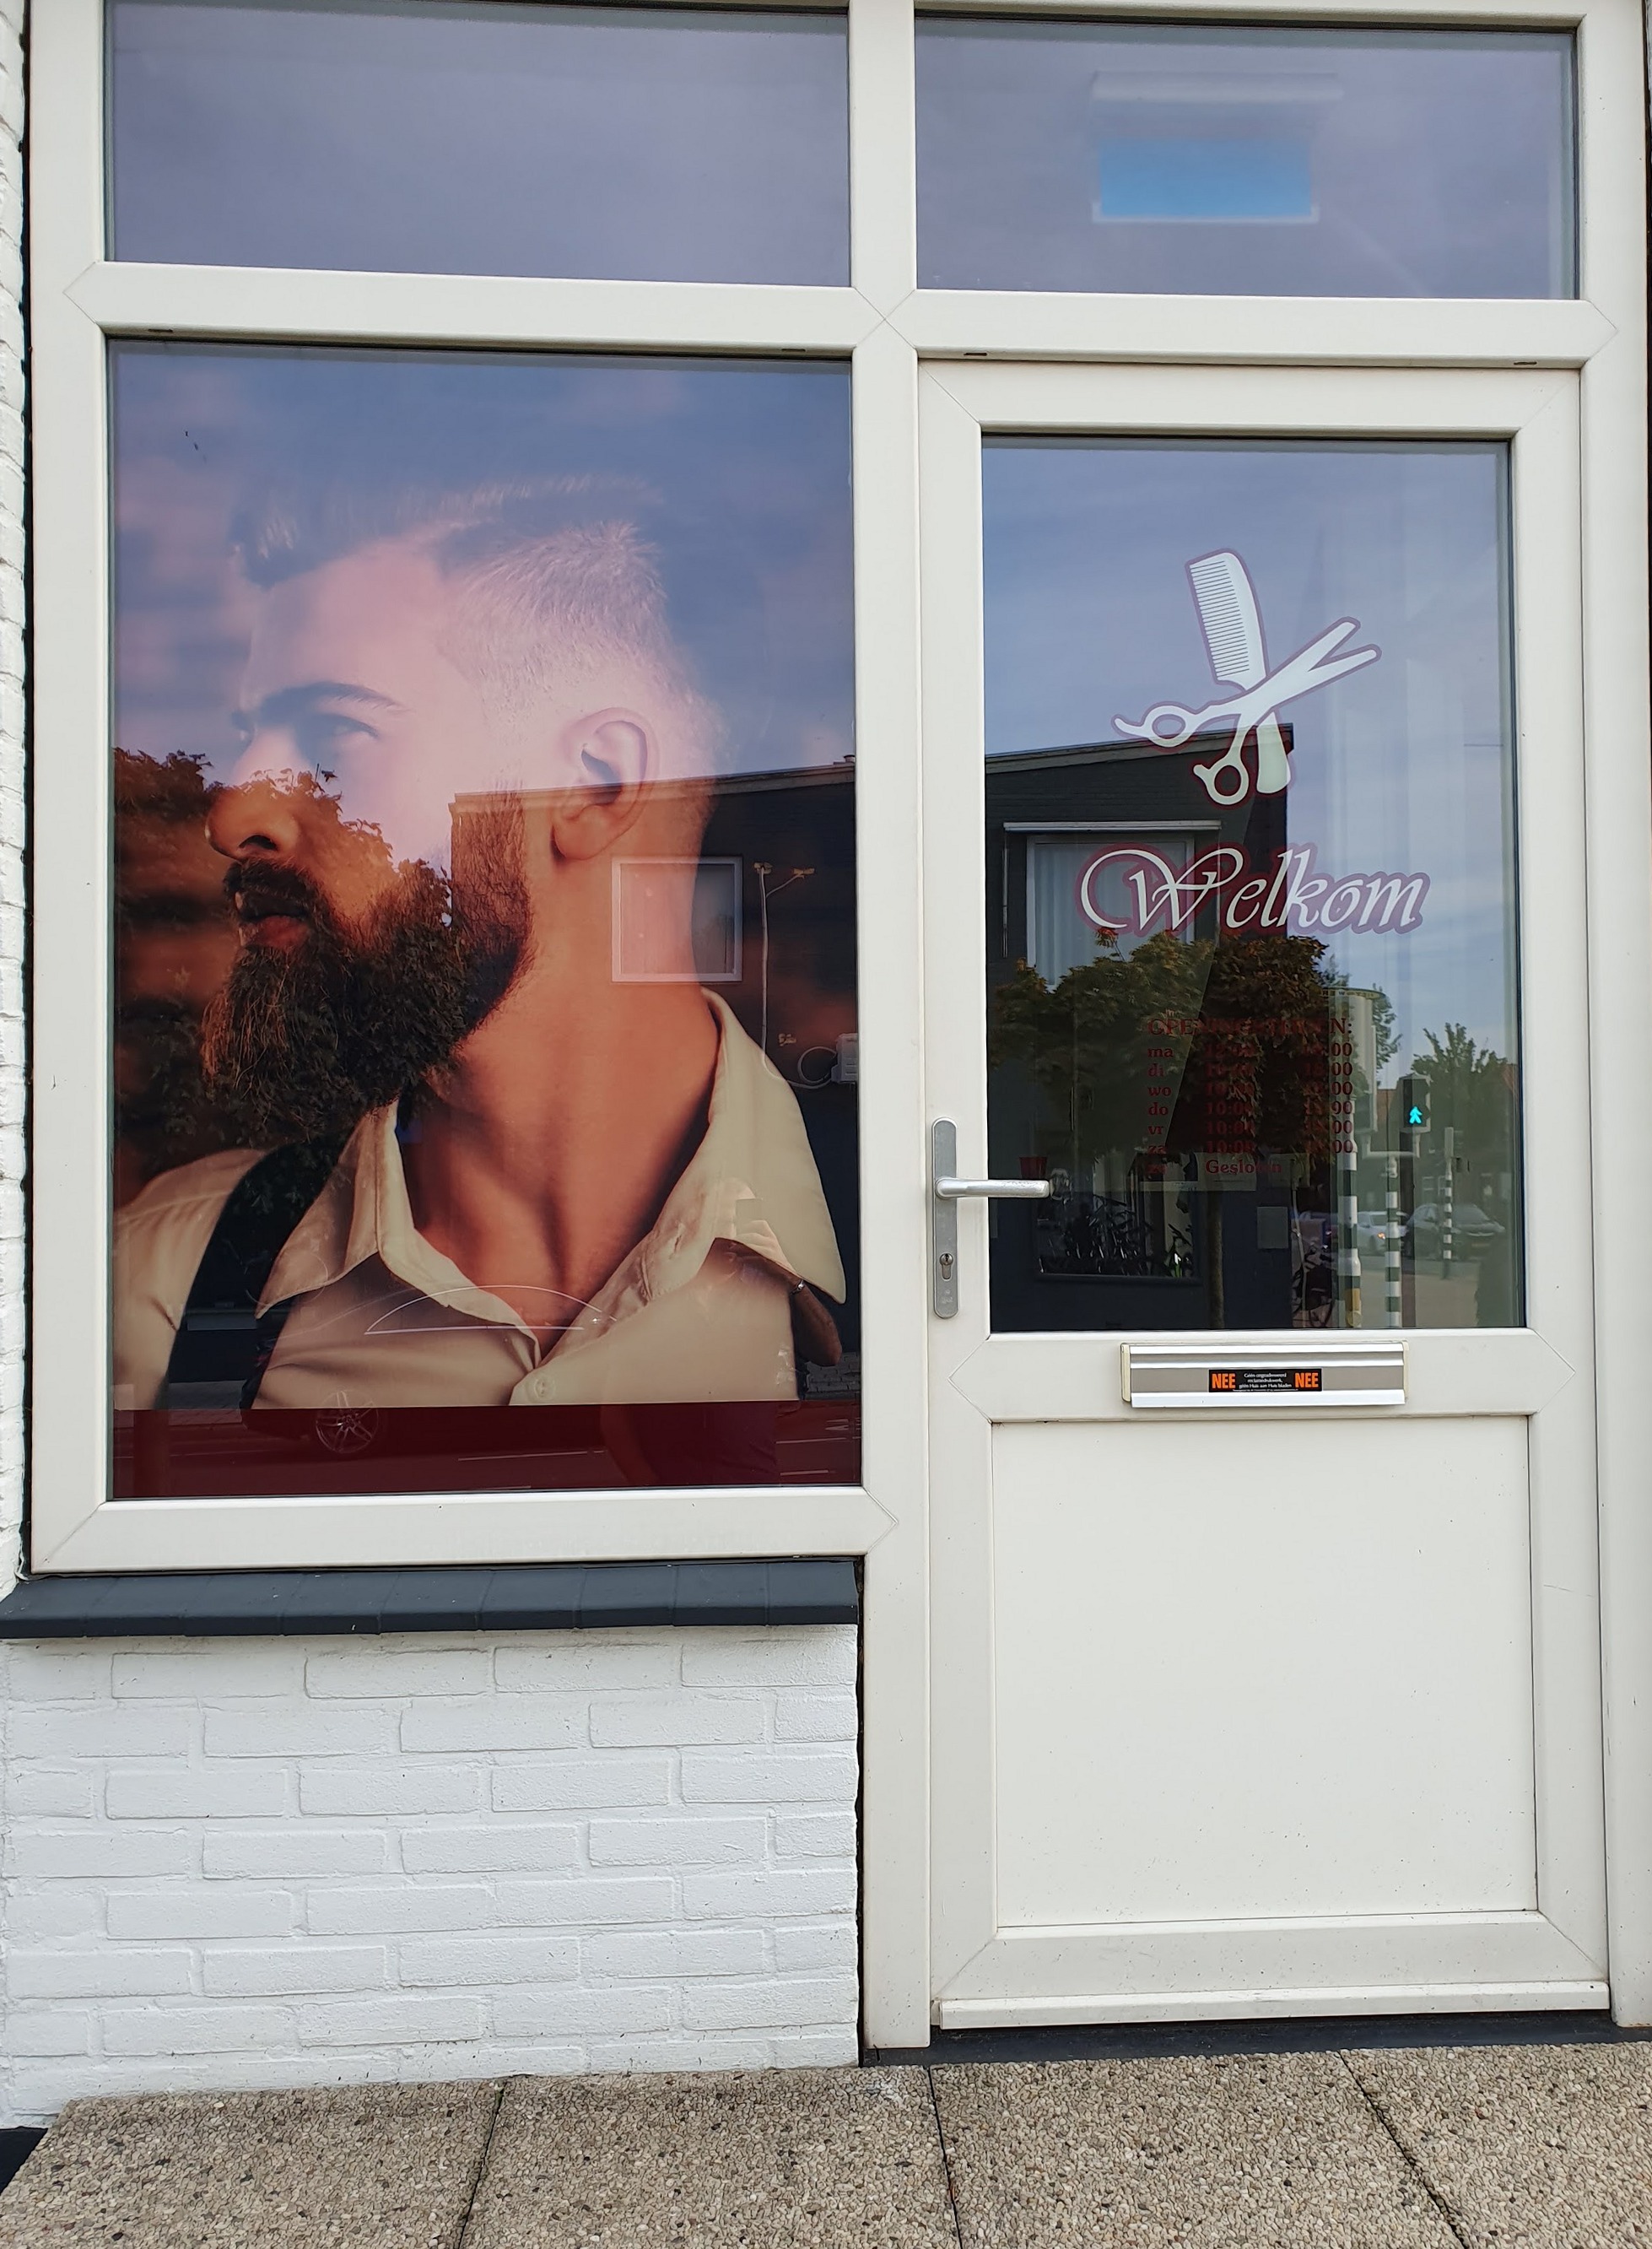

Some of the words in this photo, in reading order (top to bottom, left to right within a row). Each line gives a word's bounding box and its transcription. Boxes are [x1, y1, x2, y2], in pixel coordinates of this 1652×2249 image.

[1079, 846, 1425, 931] Welkom
[1147, 1047, 1174, 1057] ma
[1147, 1062, 1164, 1077] di
[1147, 1086, 1172, 1096] wo
[1148, 1101, 1169, 1116] do
[1147, 1125, 1164, 1135] vr
[1212, 1373, 1236, 1389] NEE
[1294, 1372, 1320, 1388] NEE
